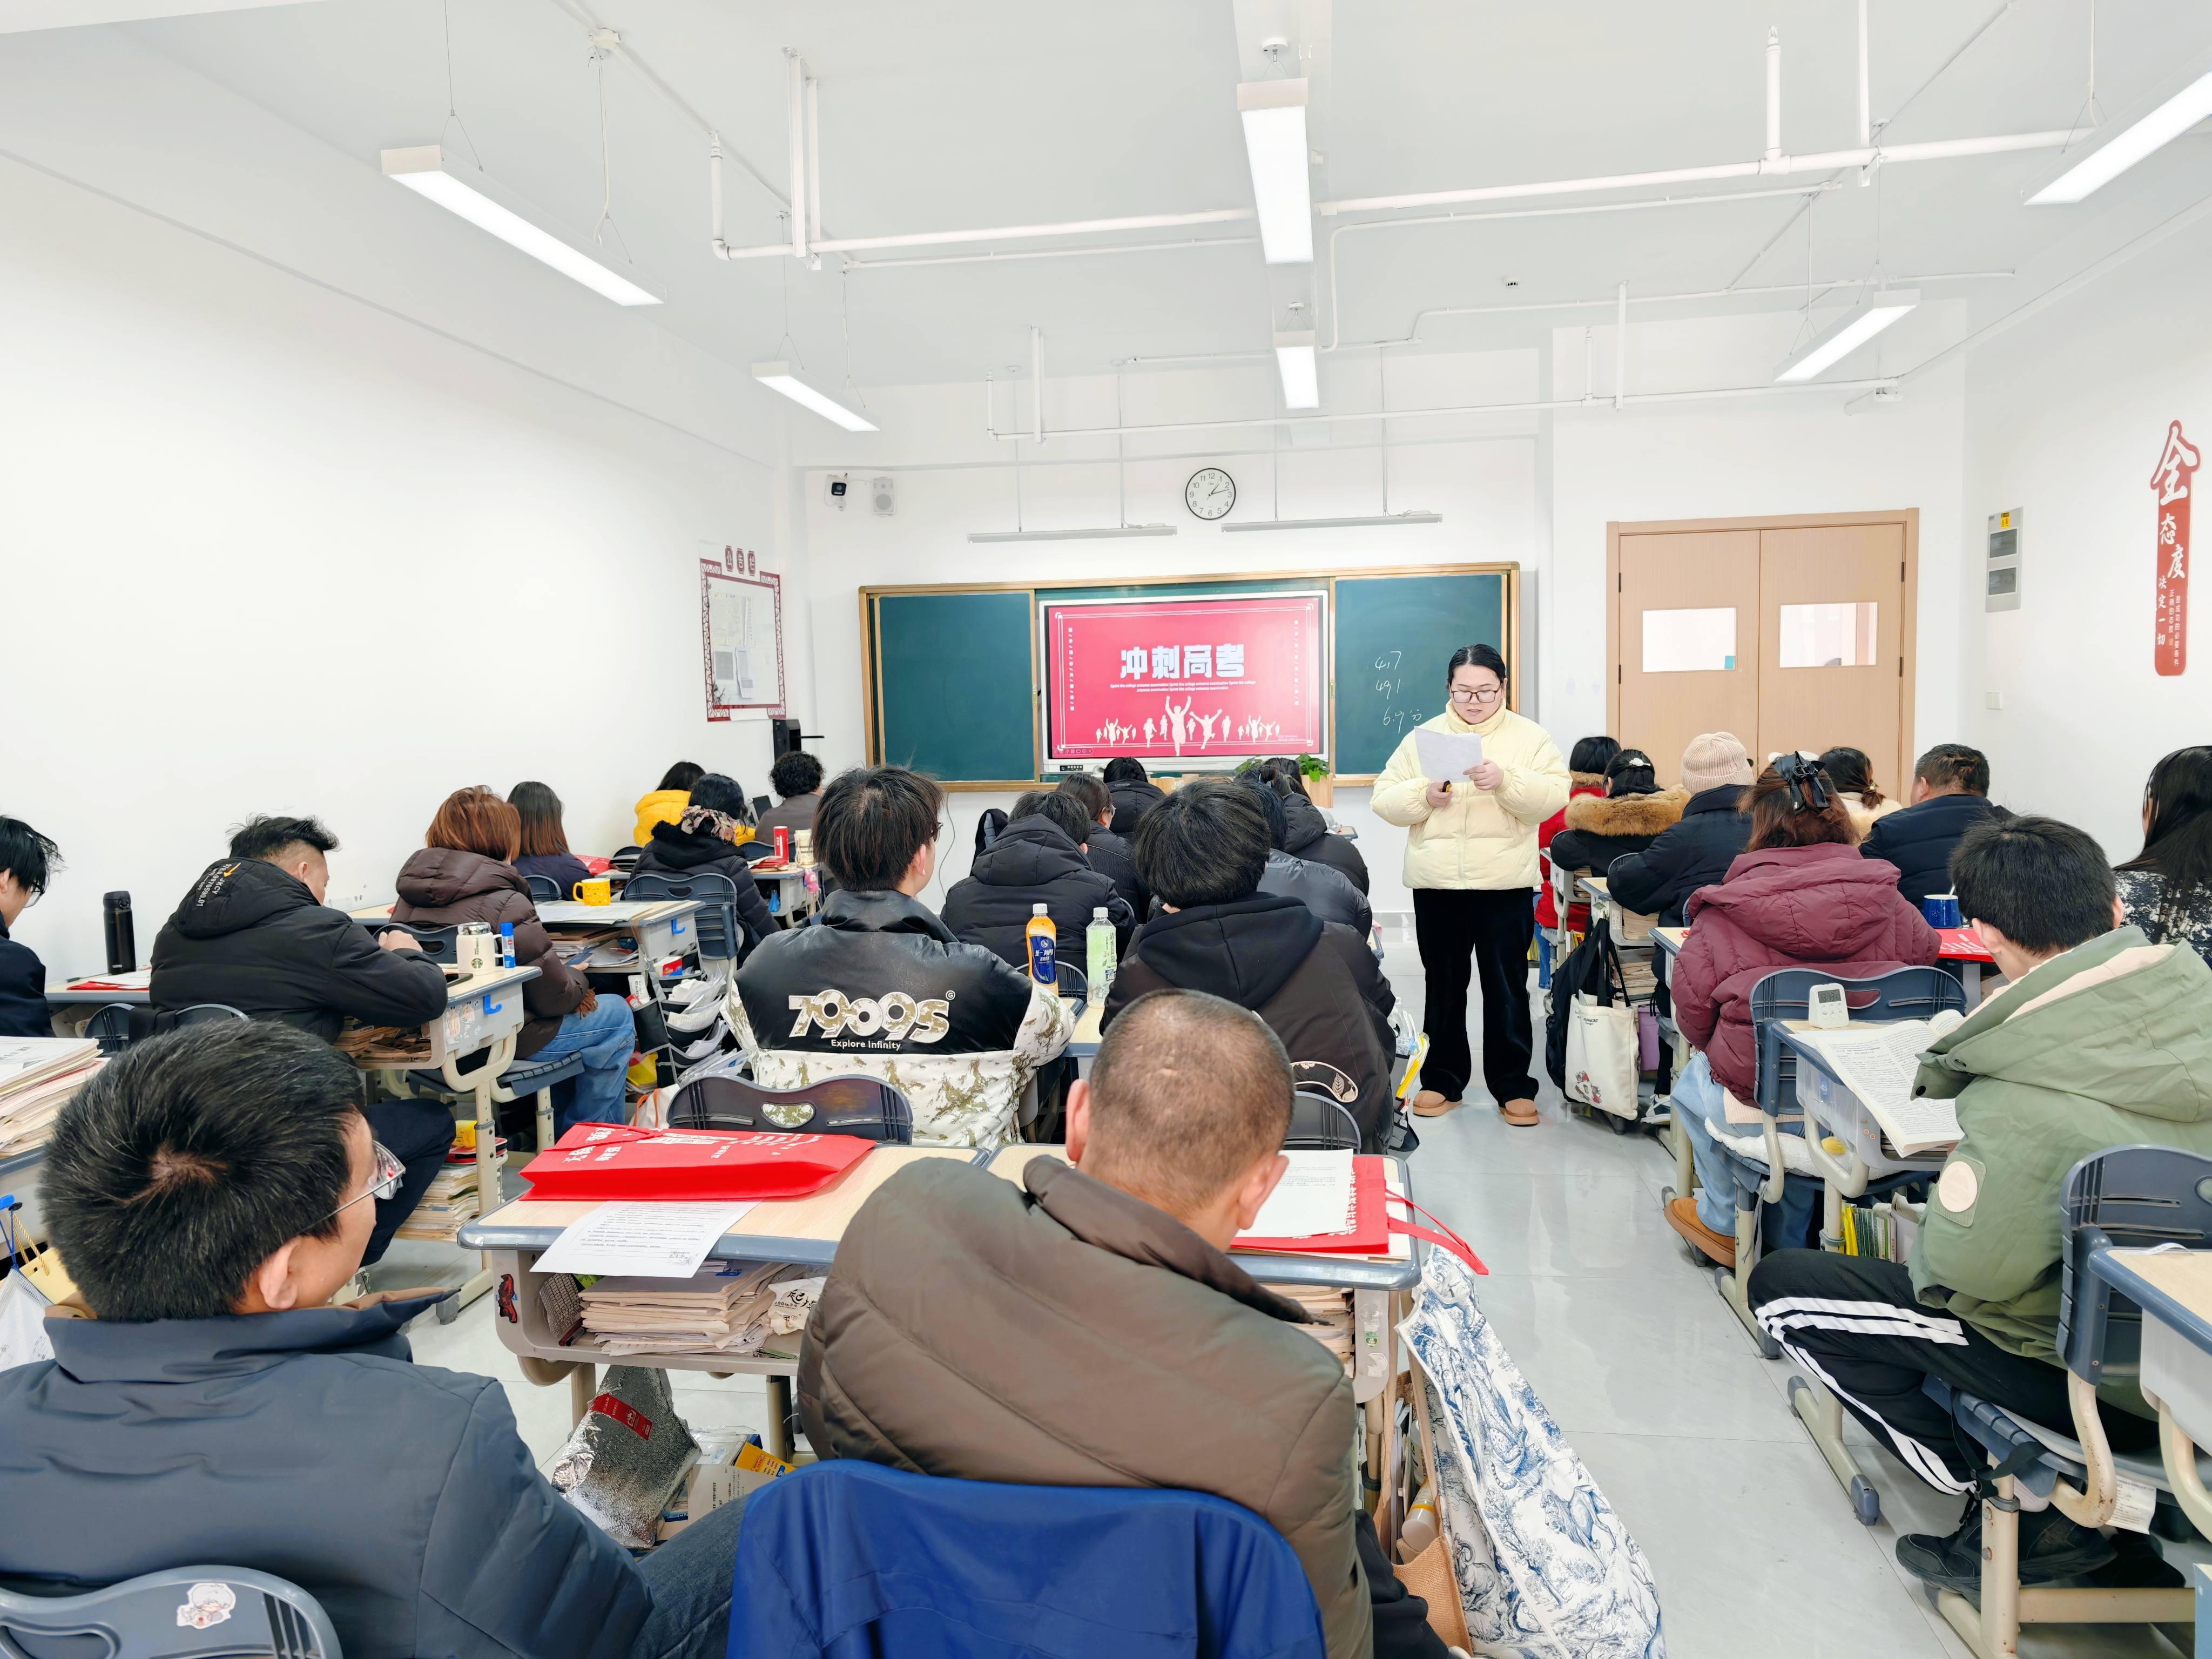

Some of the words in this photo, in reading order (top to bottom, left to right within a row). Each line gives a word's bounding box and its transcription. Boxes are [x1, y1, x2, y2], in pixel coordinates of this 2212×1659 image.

[1120, 644, 1245, 680] 冲刺高考
[212, 878, 225, 895] JKCY
[831, 1038, 866, 1049] Explore
[868, 1040, 901, 1051] Infinity
